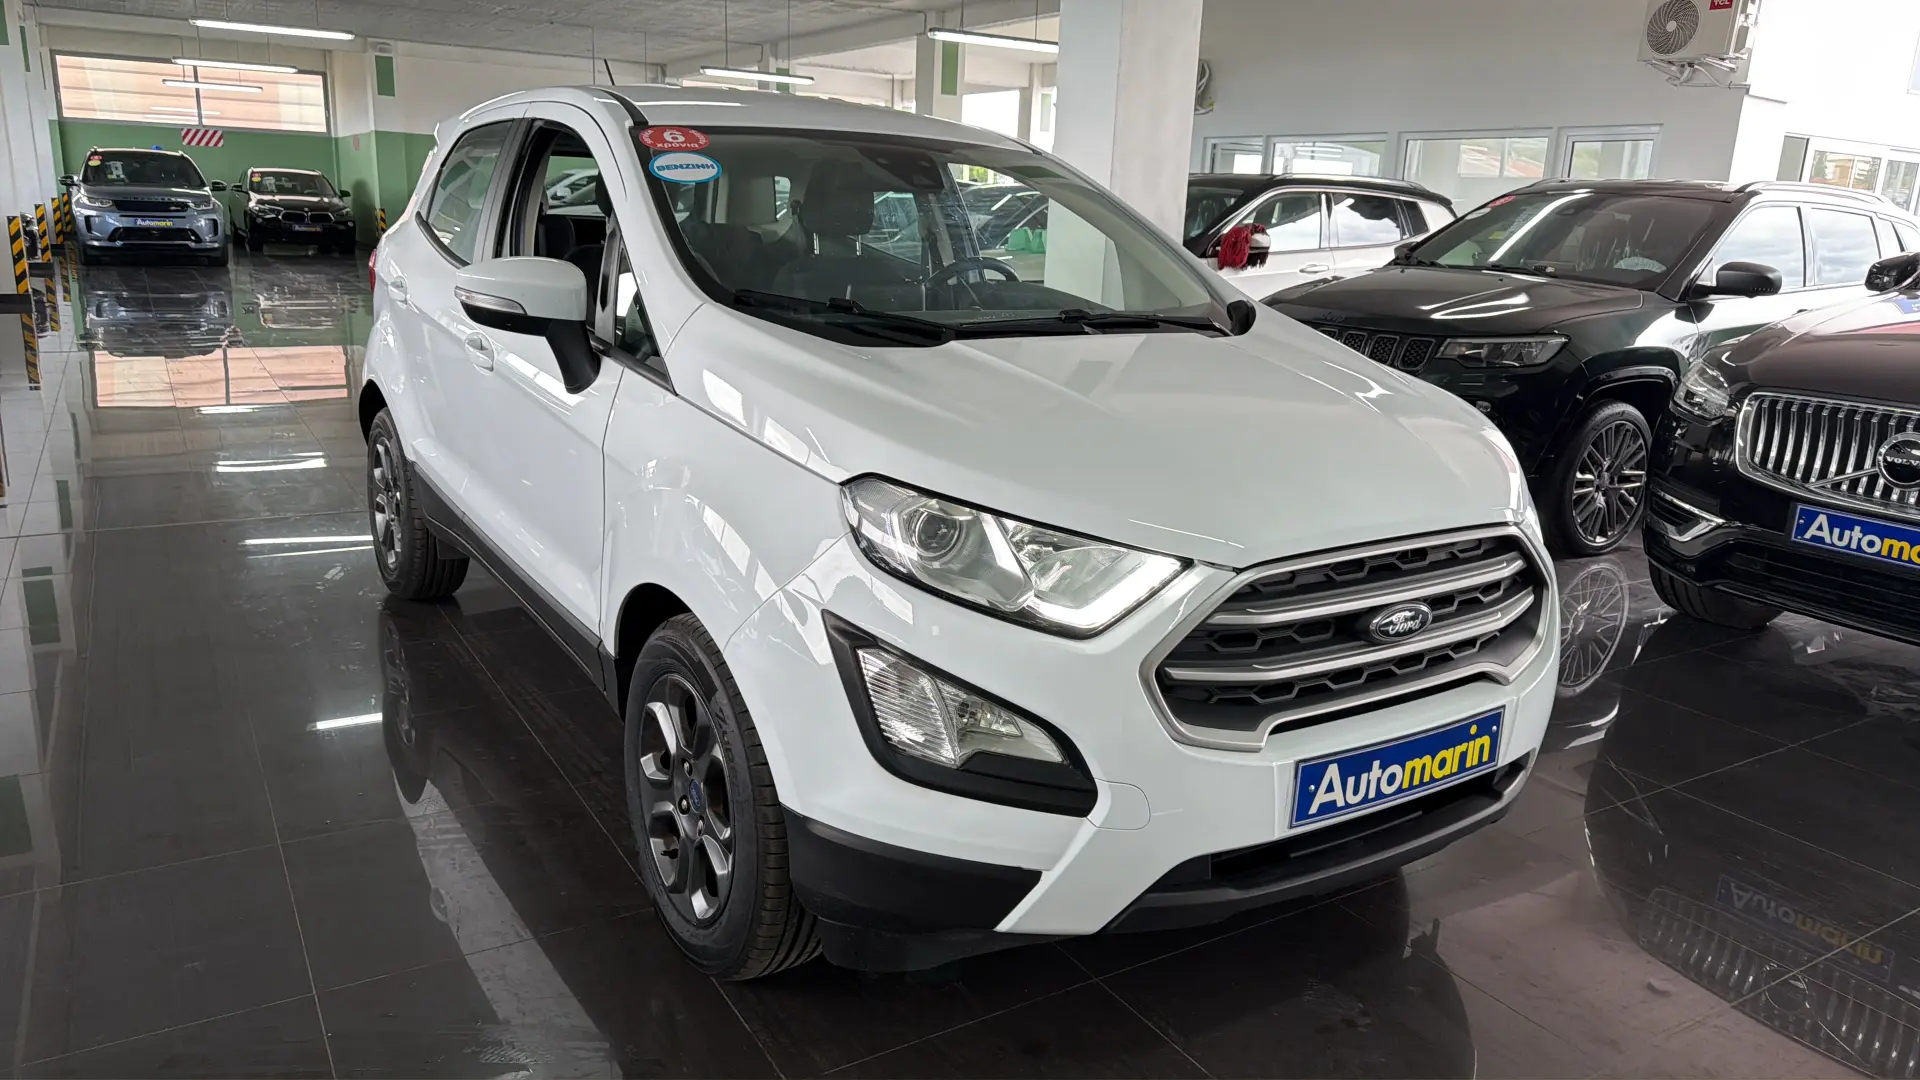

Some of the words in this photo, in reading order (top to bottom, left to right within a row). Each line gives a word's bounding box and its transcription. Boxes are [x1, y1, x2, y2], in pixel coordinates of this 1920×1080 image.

[663, 131, 686, 143] 6
[136, 218, 173, 227] Automarin
[1885, 455, 1920, 467] VOLV
[1382, 610, 1421, 634] Ford
[1308, 724, 1491, 815] Automarin
